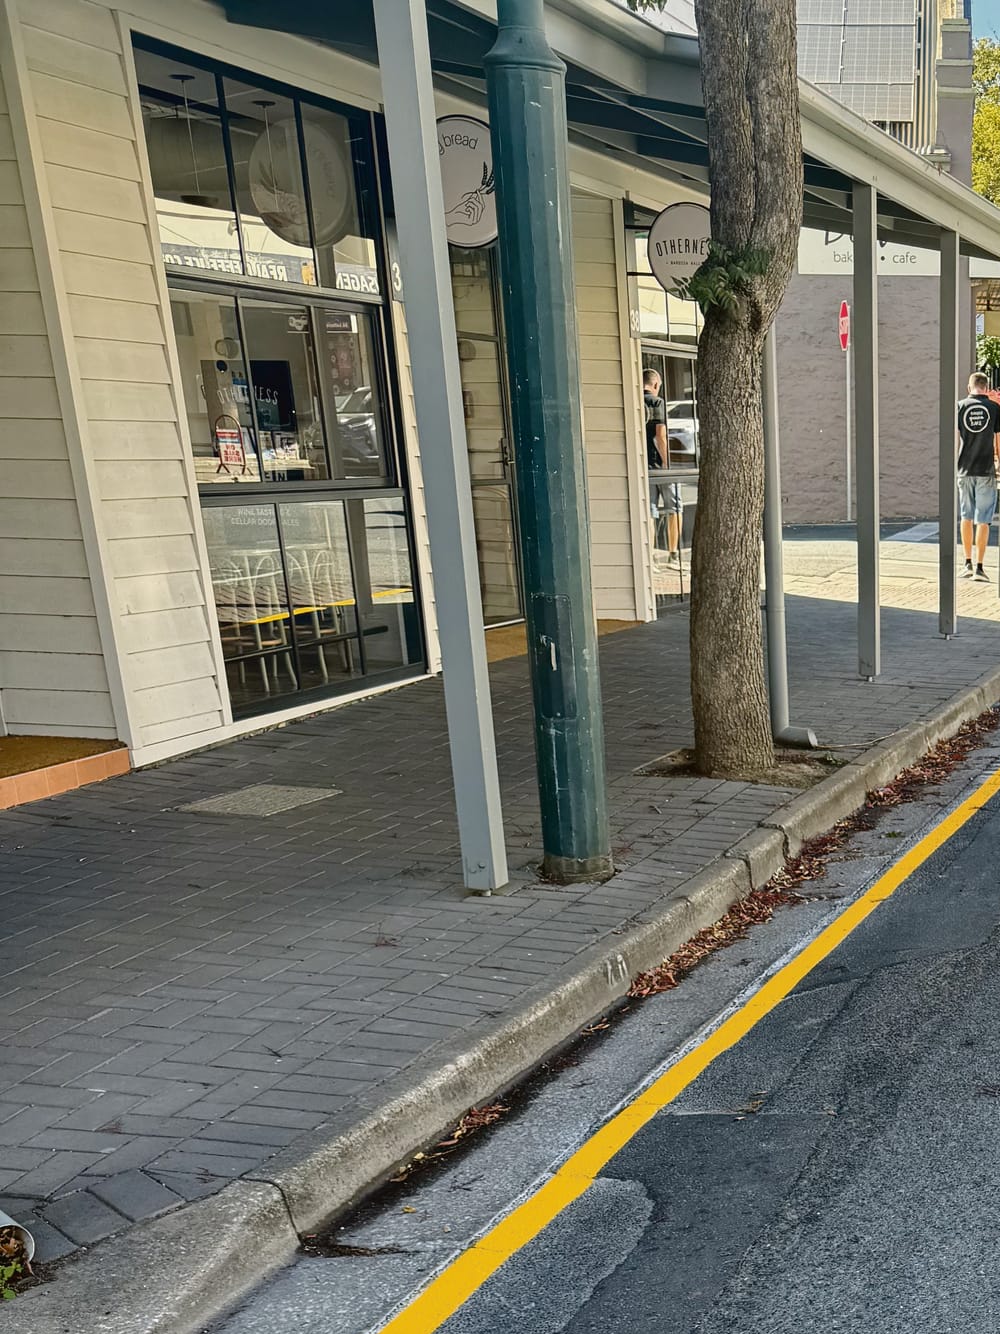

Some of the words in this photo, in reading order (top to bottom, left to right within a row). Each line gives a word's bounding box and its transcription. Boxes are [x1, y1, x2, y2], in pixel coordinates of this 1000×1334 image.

[442, 134, 478, 149] bread
[833, 251, 854, 263] bak
[892, 251, 917, 264] cafe
